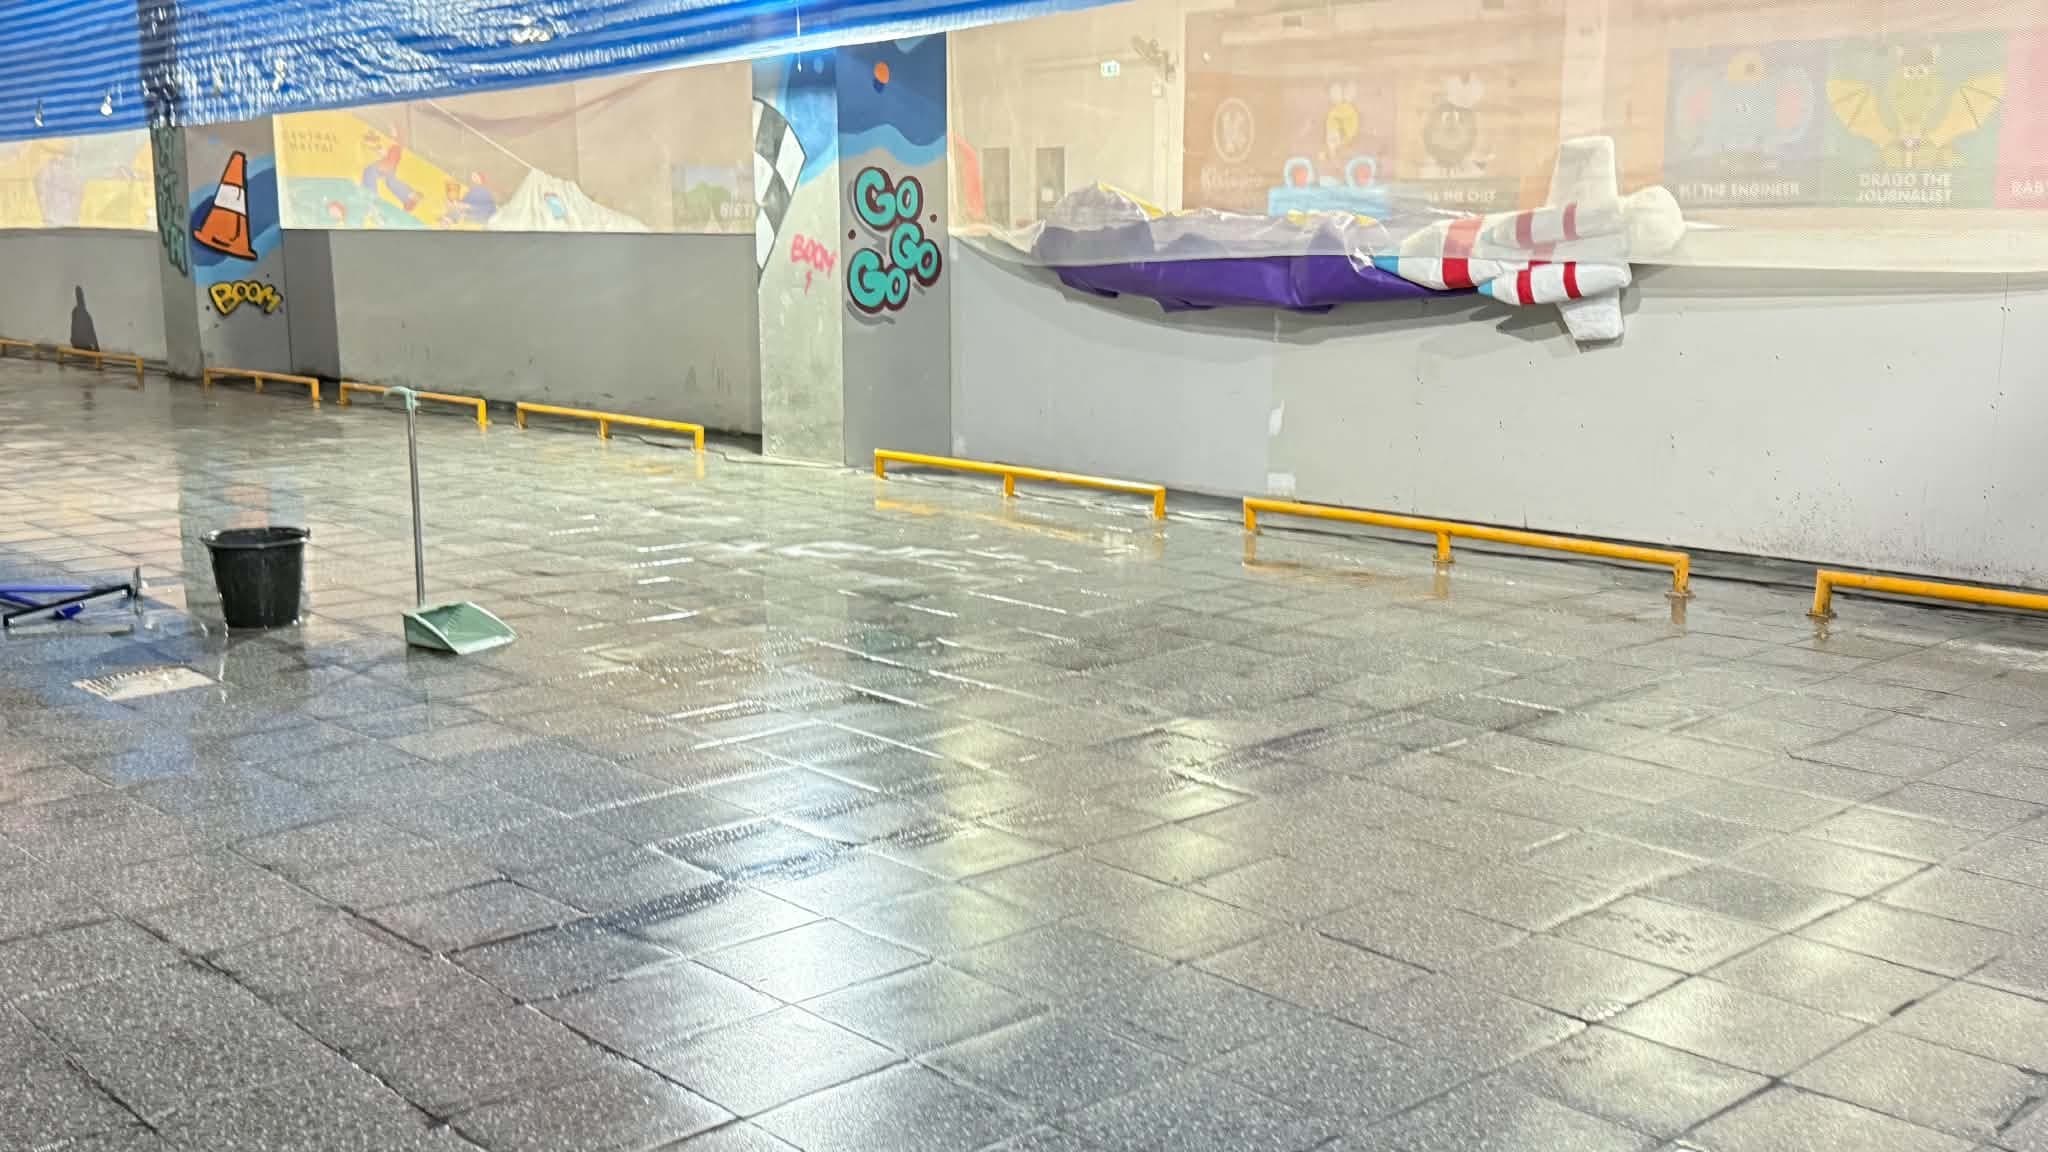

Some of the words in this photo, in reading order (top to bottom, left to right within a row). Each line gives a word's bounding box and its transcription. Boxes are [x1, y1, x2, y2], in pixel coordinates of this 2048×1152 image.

[1858, 173, 1917, 187] DRAGO
[1922, 173, 1952, 187] THE
[2010, 179, 2048, 195] RAB
[1731, 183, 1800, 197] ENGINEER
[1856, 188, 1952, 203] JOURNALIST
[209, 280, 284, 316] BOOM
